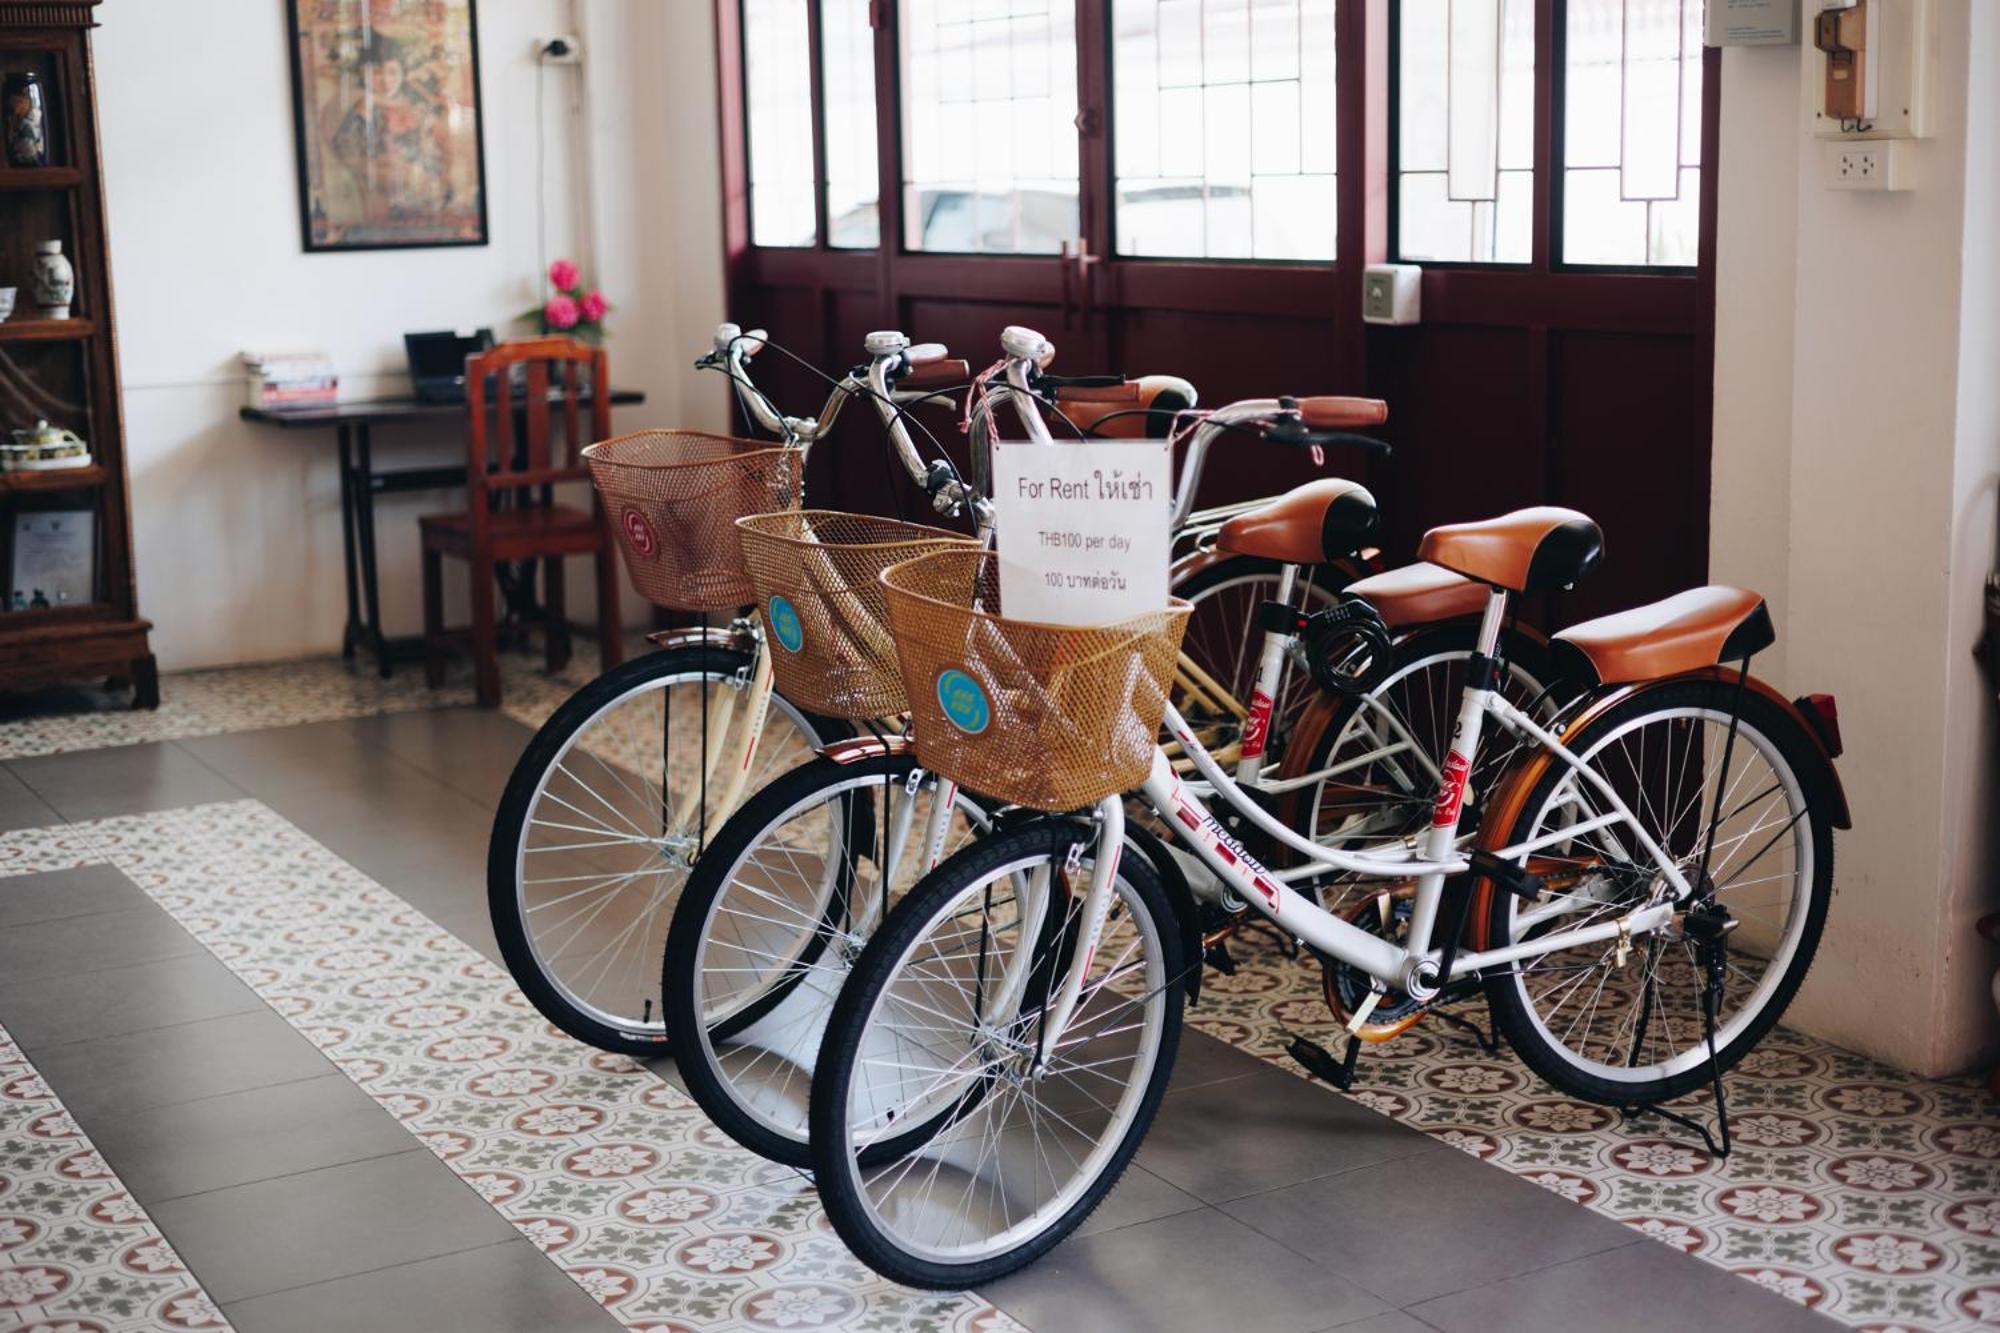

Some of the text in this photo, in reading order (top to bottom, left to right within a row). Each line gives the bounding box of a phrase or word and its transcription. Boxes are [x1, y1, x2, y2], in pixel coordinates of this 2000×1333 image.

[1018, 469, 1153, 500] For Rent ให้เช่า
[1038, 531, 1131, 553] THB100 per day
[1045, 570, 1127, 590] 100 บาทต่อวัน
